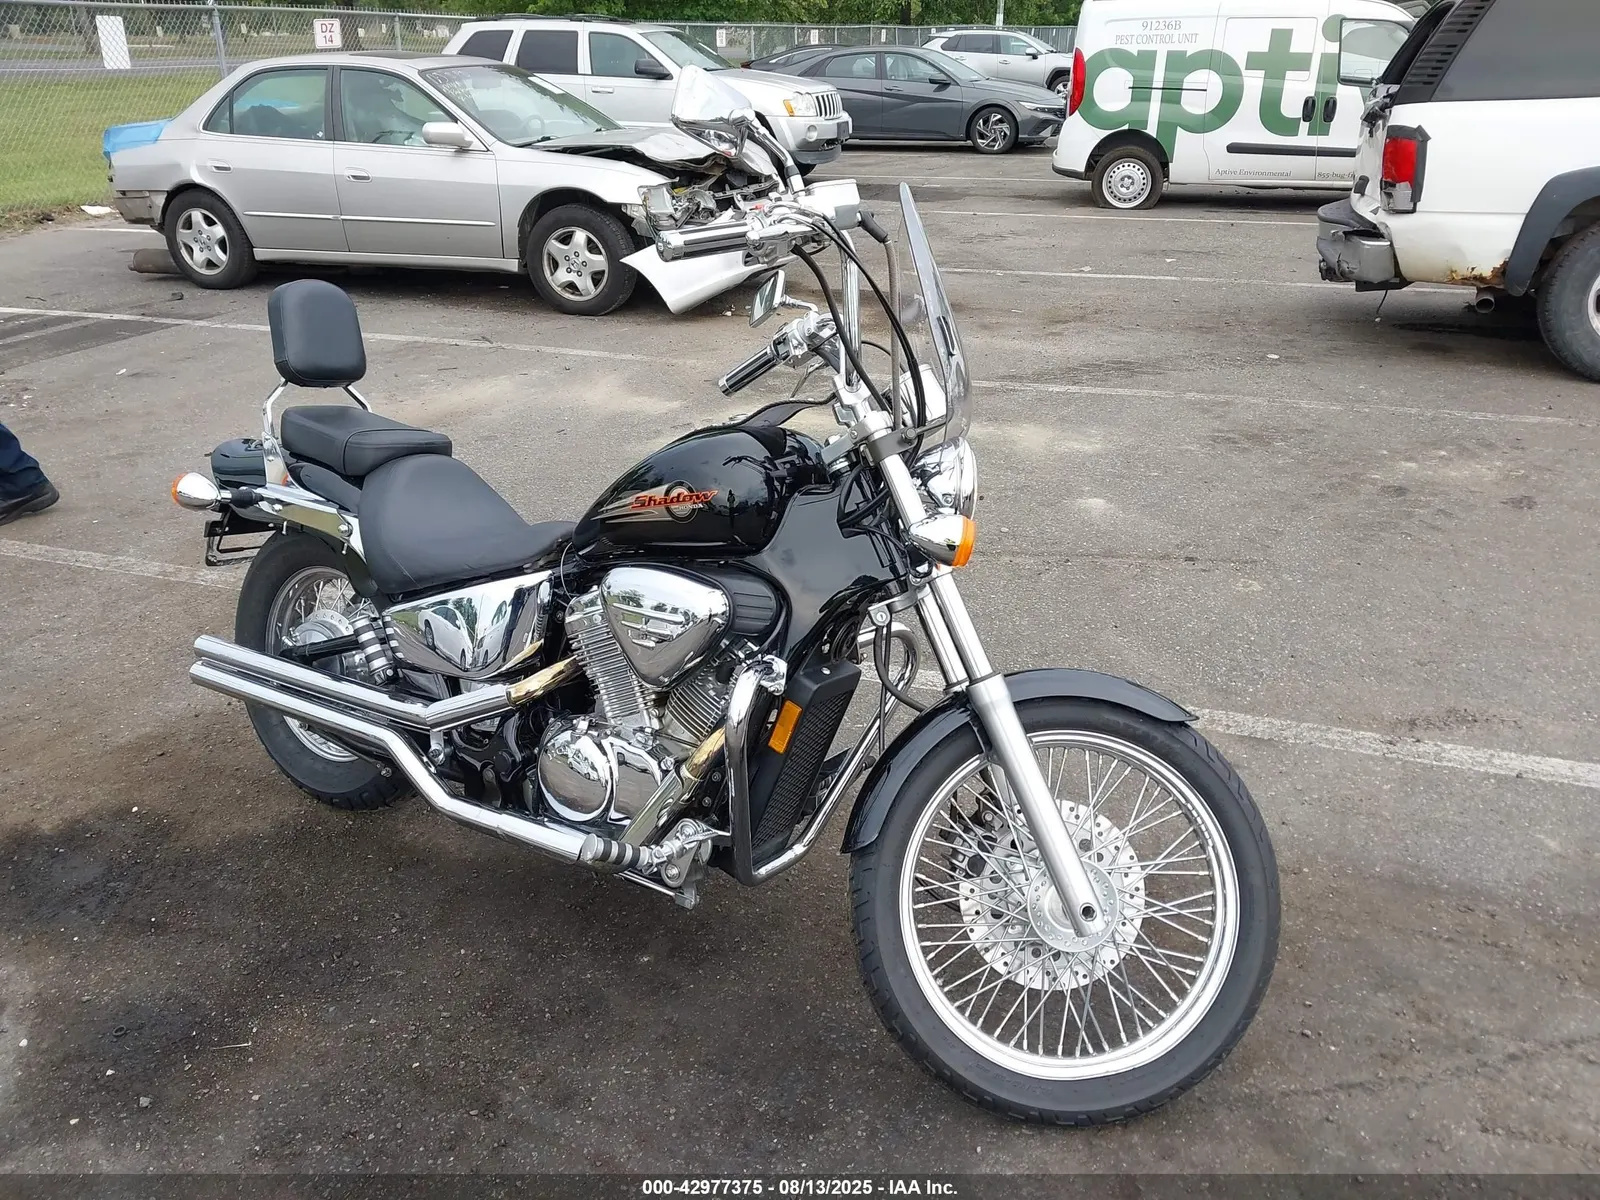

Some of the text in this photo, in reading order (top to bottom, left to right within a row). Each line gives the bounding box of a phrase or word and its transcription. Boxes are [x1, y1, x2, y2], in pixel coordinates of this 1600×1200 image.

[320, 23, 335, 33] DZ
[1141, 20, 1182, 31] 91236B
[323, 34, 334, 44] 14
[1115, 33, 1200, 45] PEST CONTROL UNIT
[1078, 14, 1372, 163] apti
[1239, 169, 1291, 177] Environmental
[631, 490, 718, 509] Shadow
[679, 502, 704, 510] HONDA
